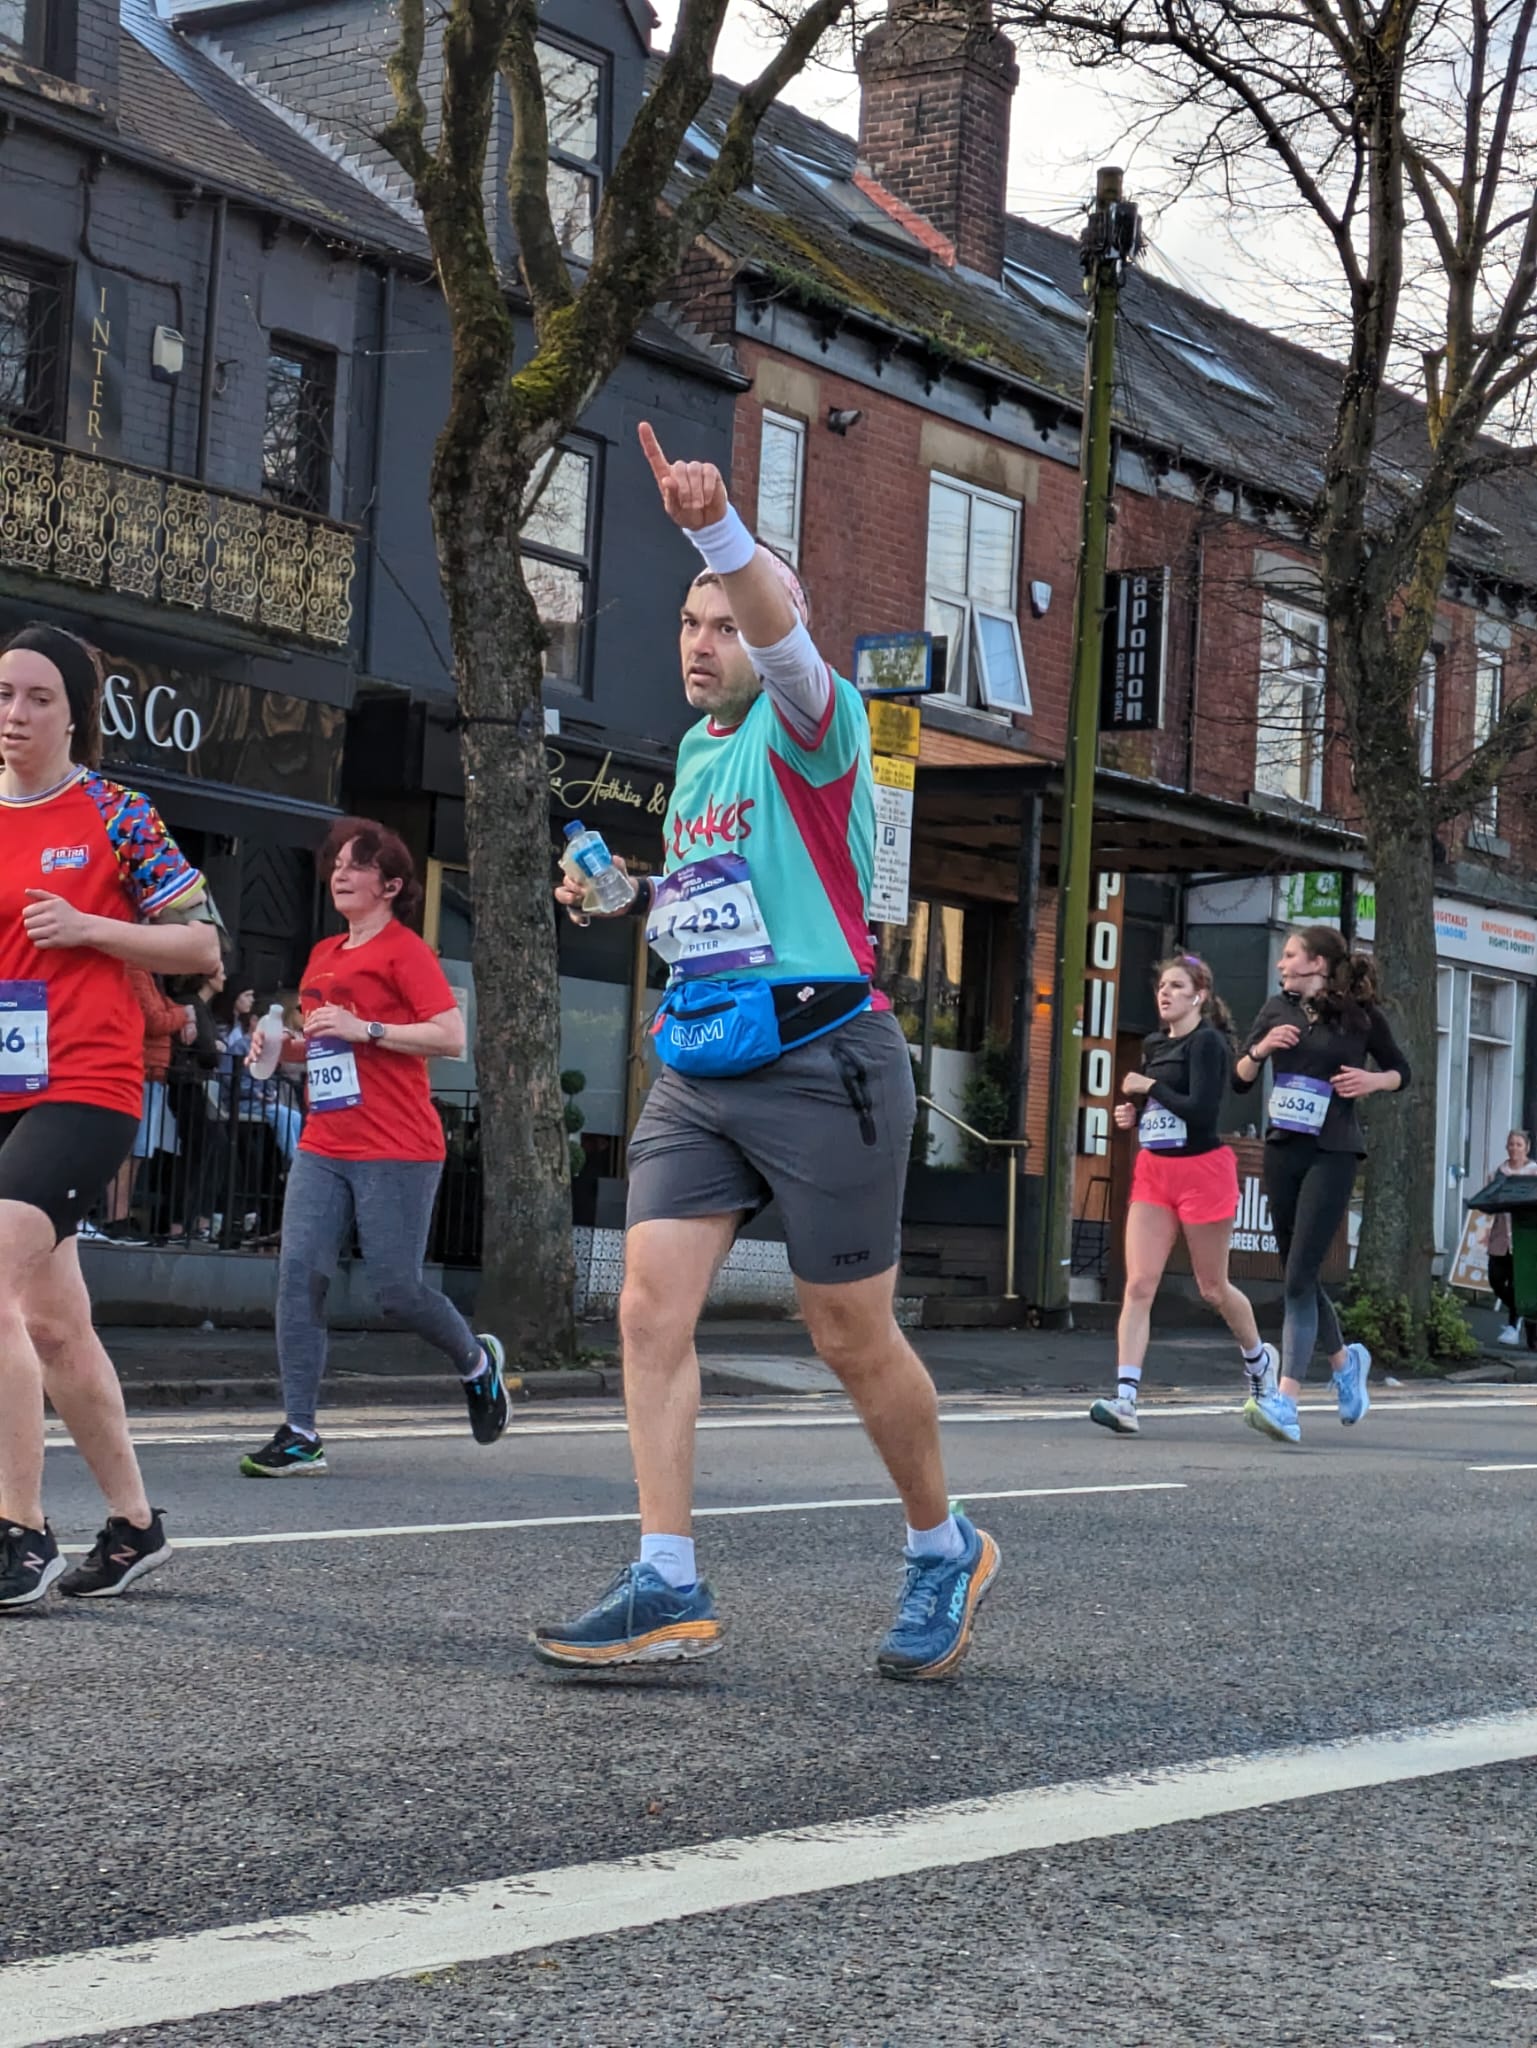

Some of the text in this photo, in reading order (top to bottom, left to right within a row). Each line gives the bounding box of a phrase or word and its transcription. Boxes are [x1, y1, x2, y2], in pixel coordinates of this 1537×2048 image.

[1126, 576, 1148, 722] apollon
[1115, 652, 1126, 689] GREEK
[646, 782, 667, 815] &
[668, 902, 741, 938] 1423
[688, 940, 719, 952] PETER
[1278, 1097, 1316, 1114] 3634
[1145, 1116, 1177, 1130] 3652
